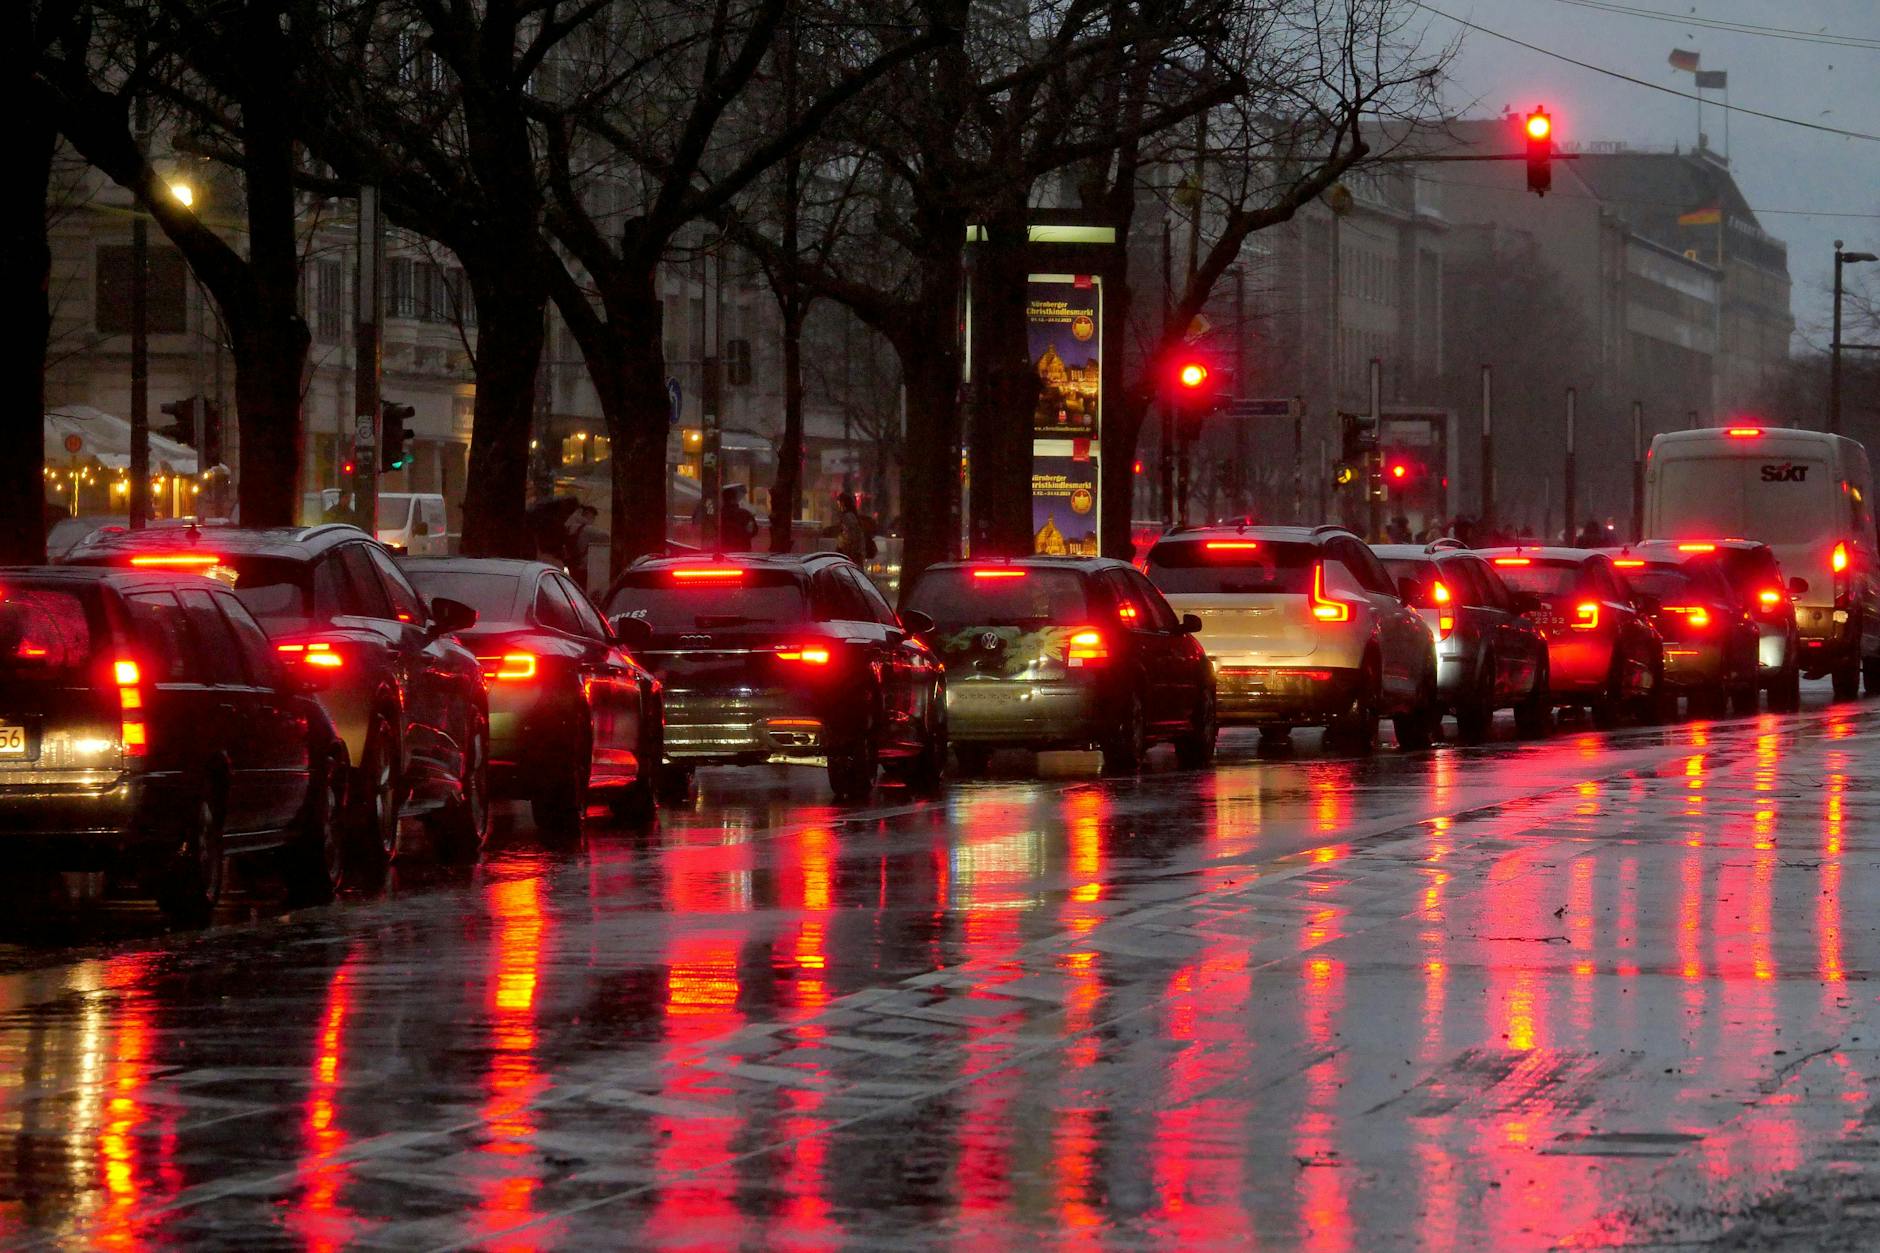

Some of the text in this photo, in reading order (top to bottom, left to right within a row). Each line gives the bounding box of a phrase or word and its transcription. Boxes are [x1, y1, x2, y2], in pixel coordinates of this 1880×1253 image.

[1026, 308, 1094, 316] Christkindlesmarkt
[1761, 462, 1809, 482] SIXT
[1032, 481, 1092, 489] ristkindlesmarkt
[0, 729, 20, 749] 56
